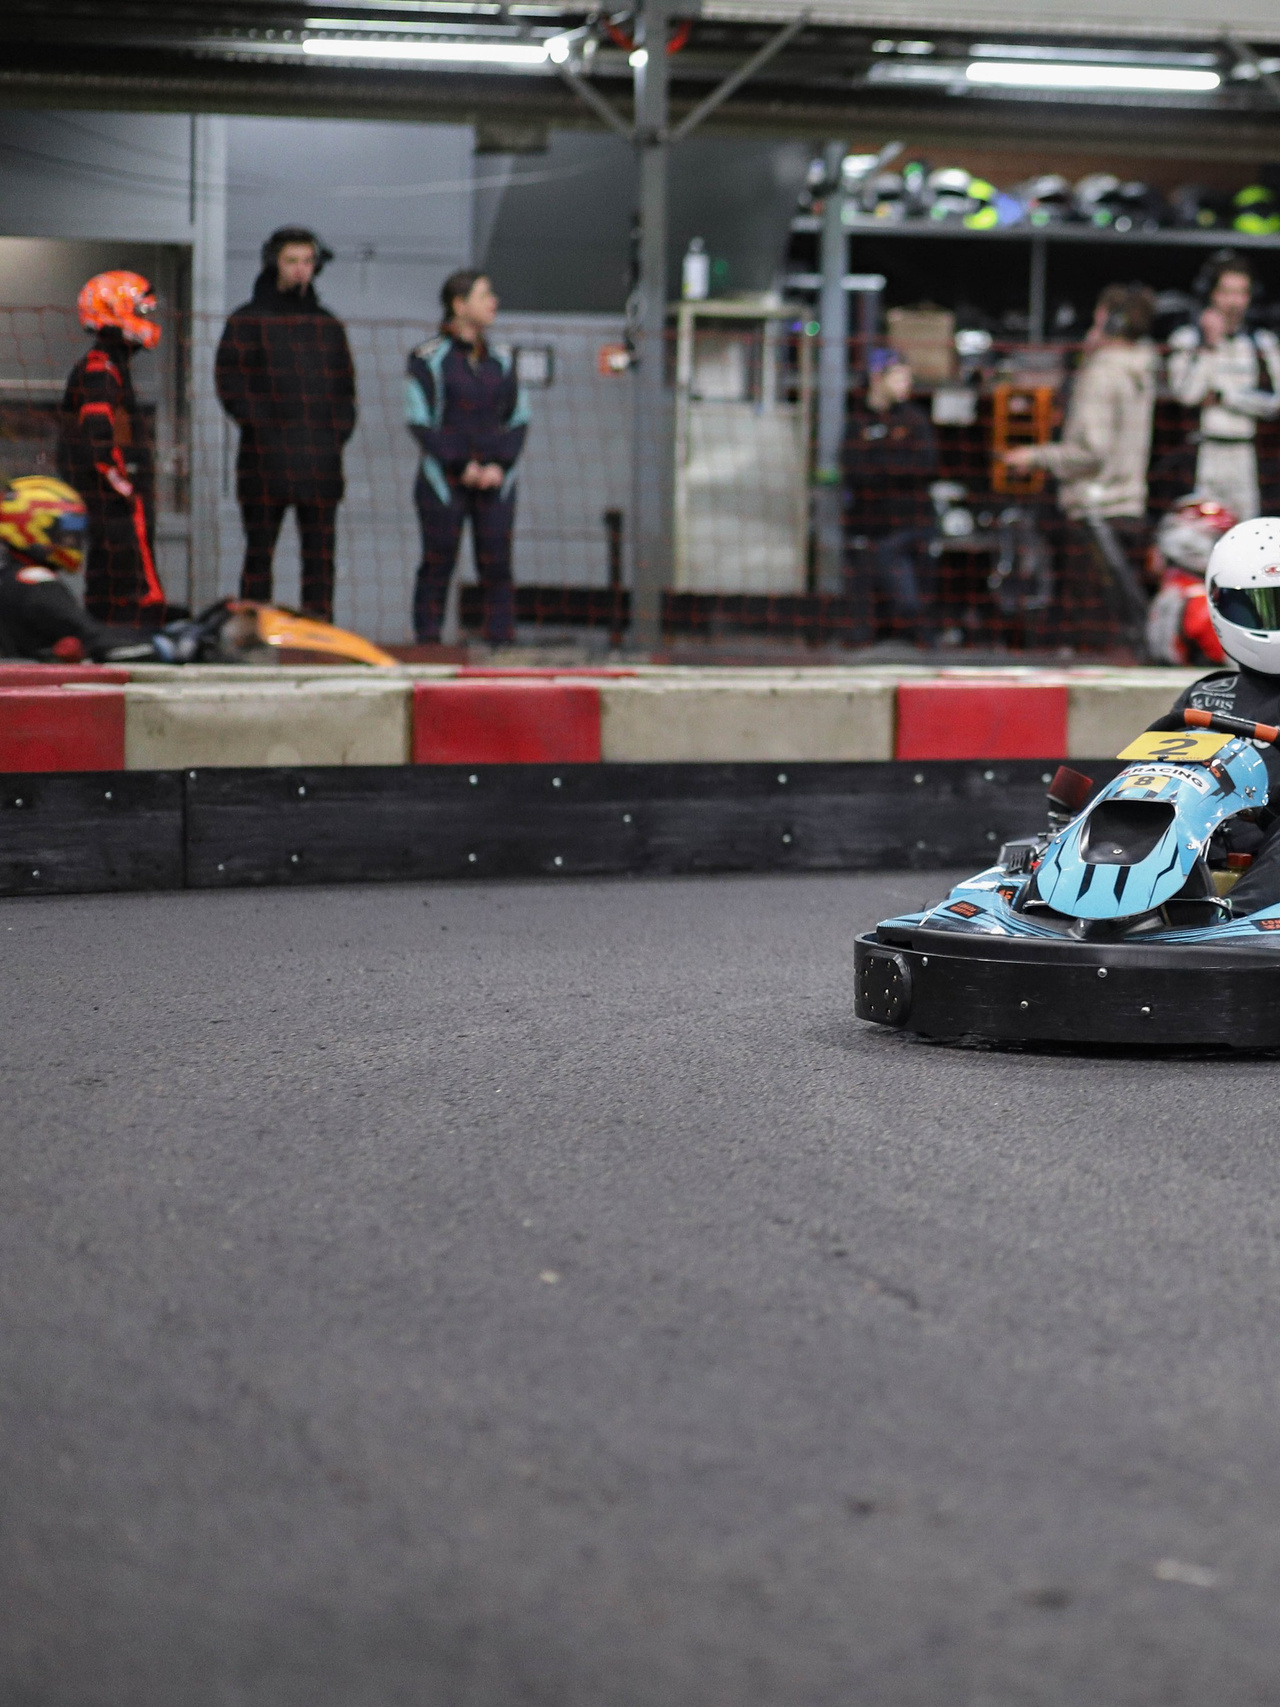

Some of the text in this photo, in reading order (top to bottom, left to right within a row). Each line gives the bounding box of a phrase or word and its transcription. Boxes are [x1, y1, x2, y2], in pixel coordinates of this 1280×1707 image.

[1148, 738, 1198, 755] 2
[1132, 767, 1203, 788] RACING
[1134, 776, 1155, 786] 8
